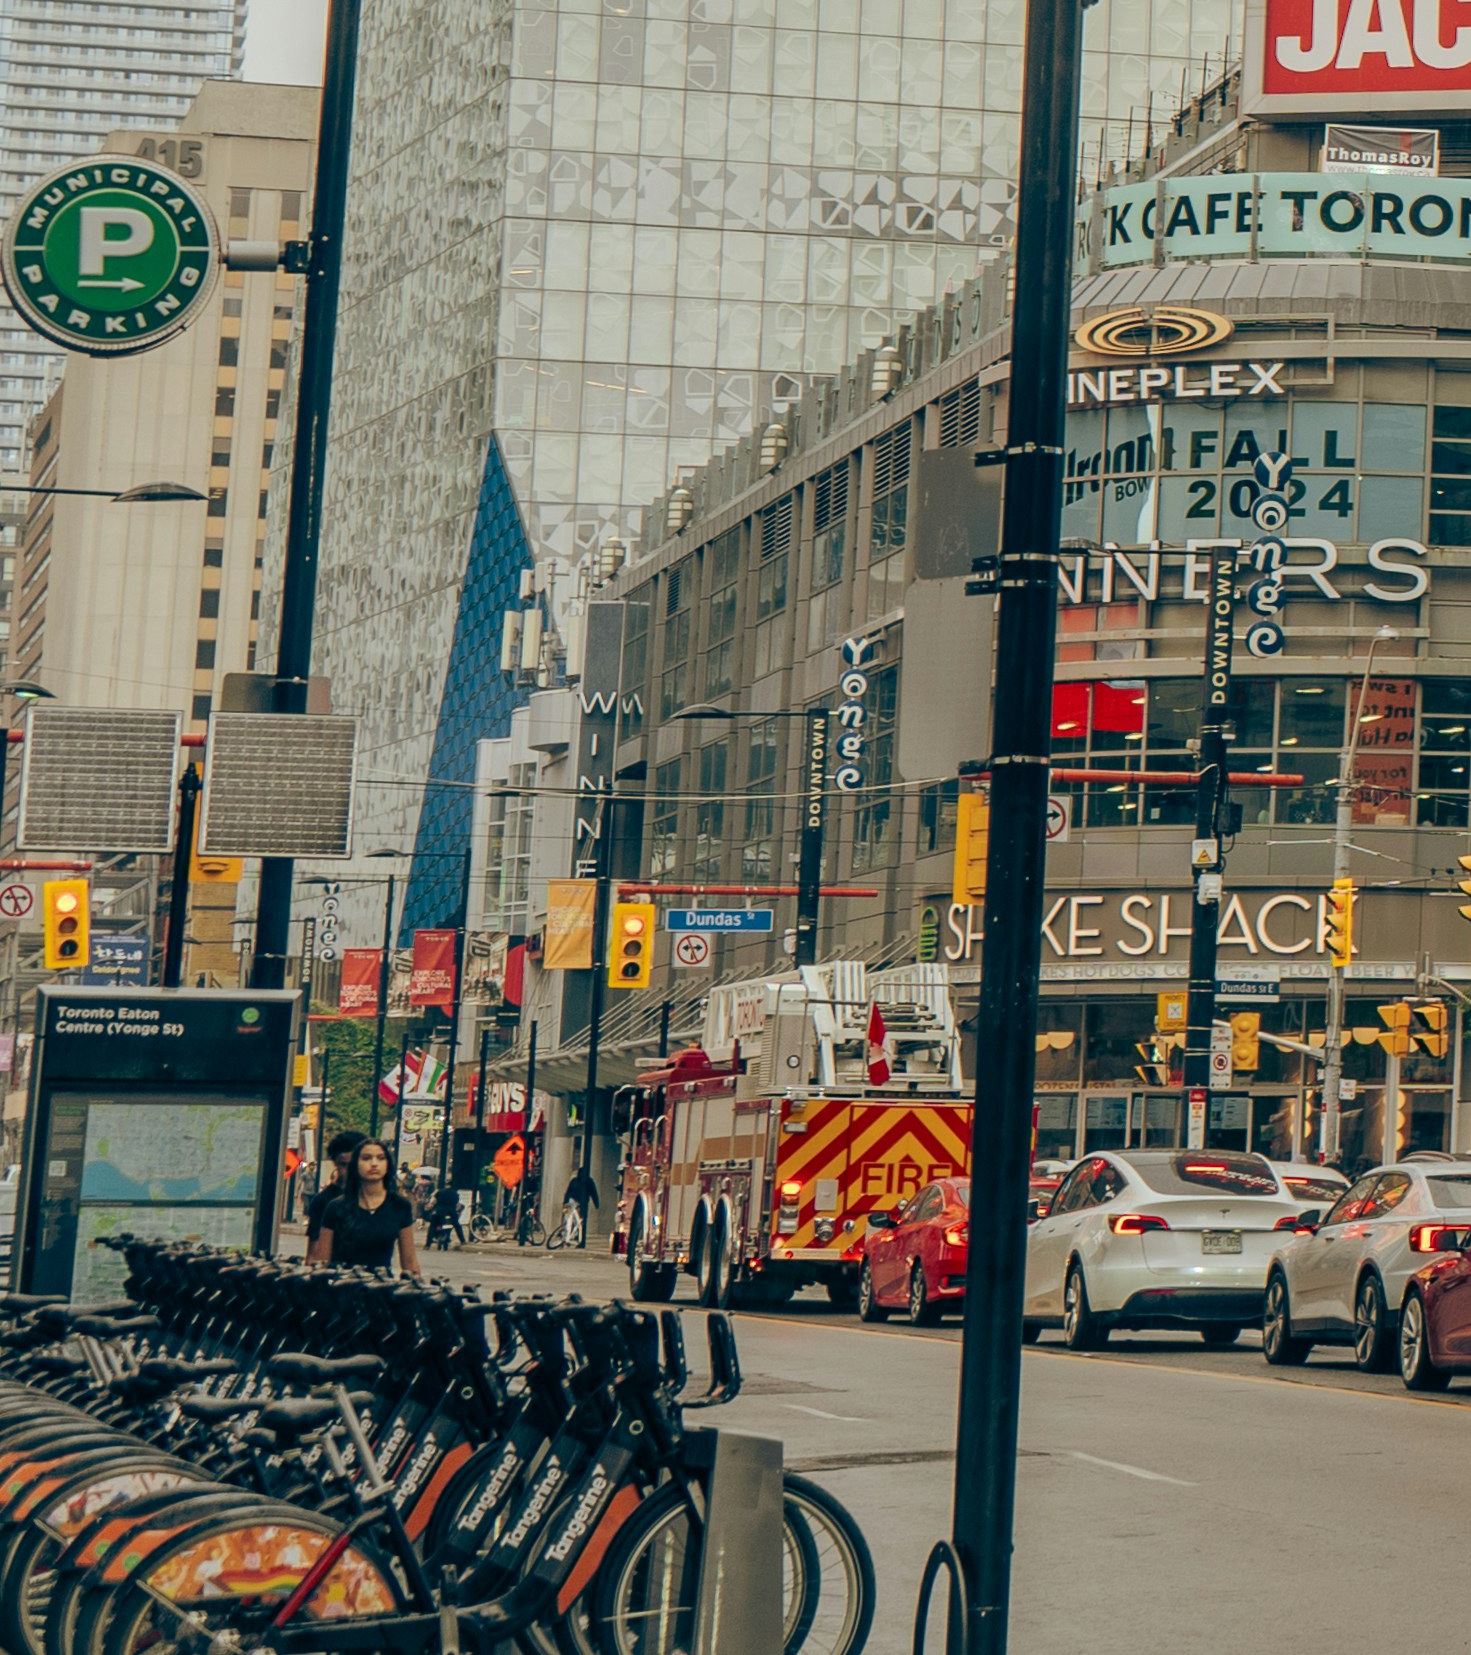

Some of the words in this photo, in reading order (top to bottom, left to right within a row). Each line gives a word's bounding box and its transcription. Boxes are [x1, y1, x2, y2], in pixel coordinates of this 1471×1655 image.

[1327, 145, 1433, 169] ThomasRoy
[27, 168, 198, 234] MUNICIPAL
[1141, 191, 1263, 241] CAFE
[78, 206, 155, 276] P
[22, 263, 201, 333] PARKING
[1067, 362, 1286, 404] INEPLEX
[1189, 429, 1356, 470] FALL
[1185, 479, 1355, 520] 2024
[1247, 451, 1291, 657] Yonge
[1212, 559, 1233, 705] DOWNTOWN
[837, 638, 873, 791] Yonge
[808, 716, 825, 828] DOWNTOWN
[303, 919, 315, 984] DOWNTOWN
[685, 911, 742, 927] Dundas
[945, 894, 1104, 960] SHKE
[1220, 981, 1256, 993] Dundas
[1268, 982, 1274, 993] E
[1352, 964, 1396, 977] BEER
[55, 1021, 103, 1035] Centre
[106, 1021, 159, 1037] (Yonge
[162, 1022, 184, 1036] St)
[57, 1005, 114, 1020] Toronto
[117, 1006, 160, 1021] Eaton
[861, 1162, 952, 1194] FIRE
[458, 1450, 518, 1533] Tangerine
[501, 1467, 562, 1549] Tangerine
[545, 1476, 607, 1562] Tangerine
